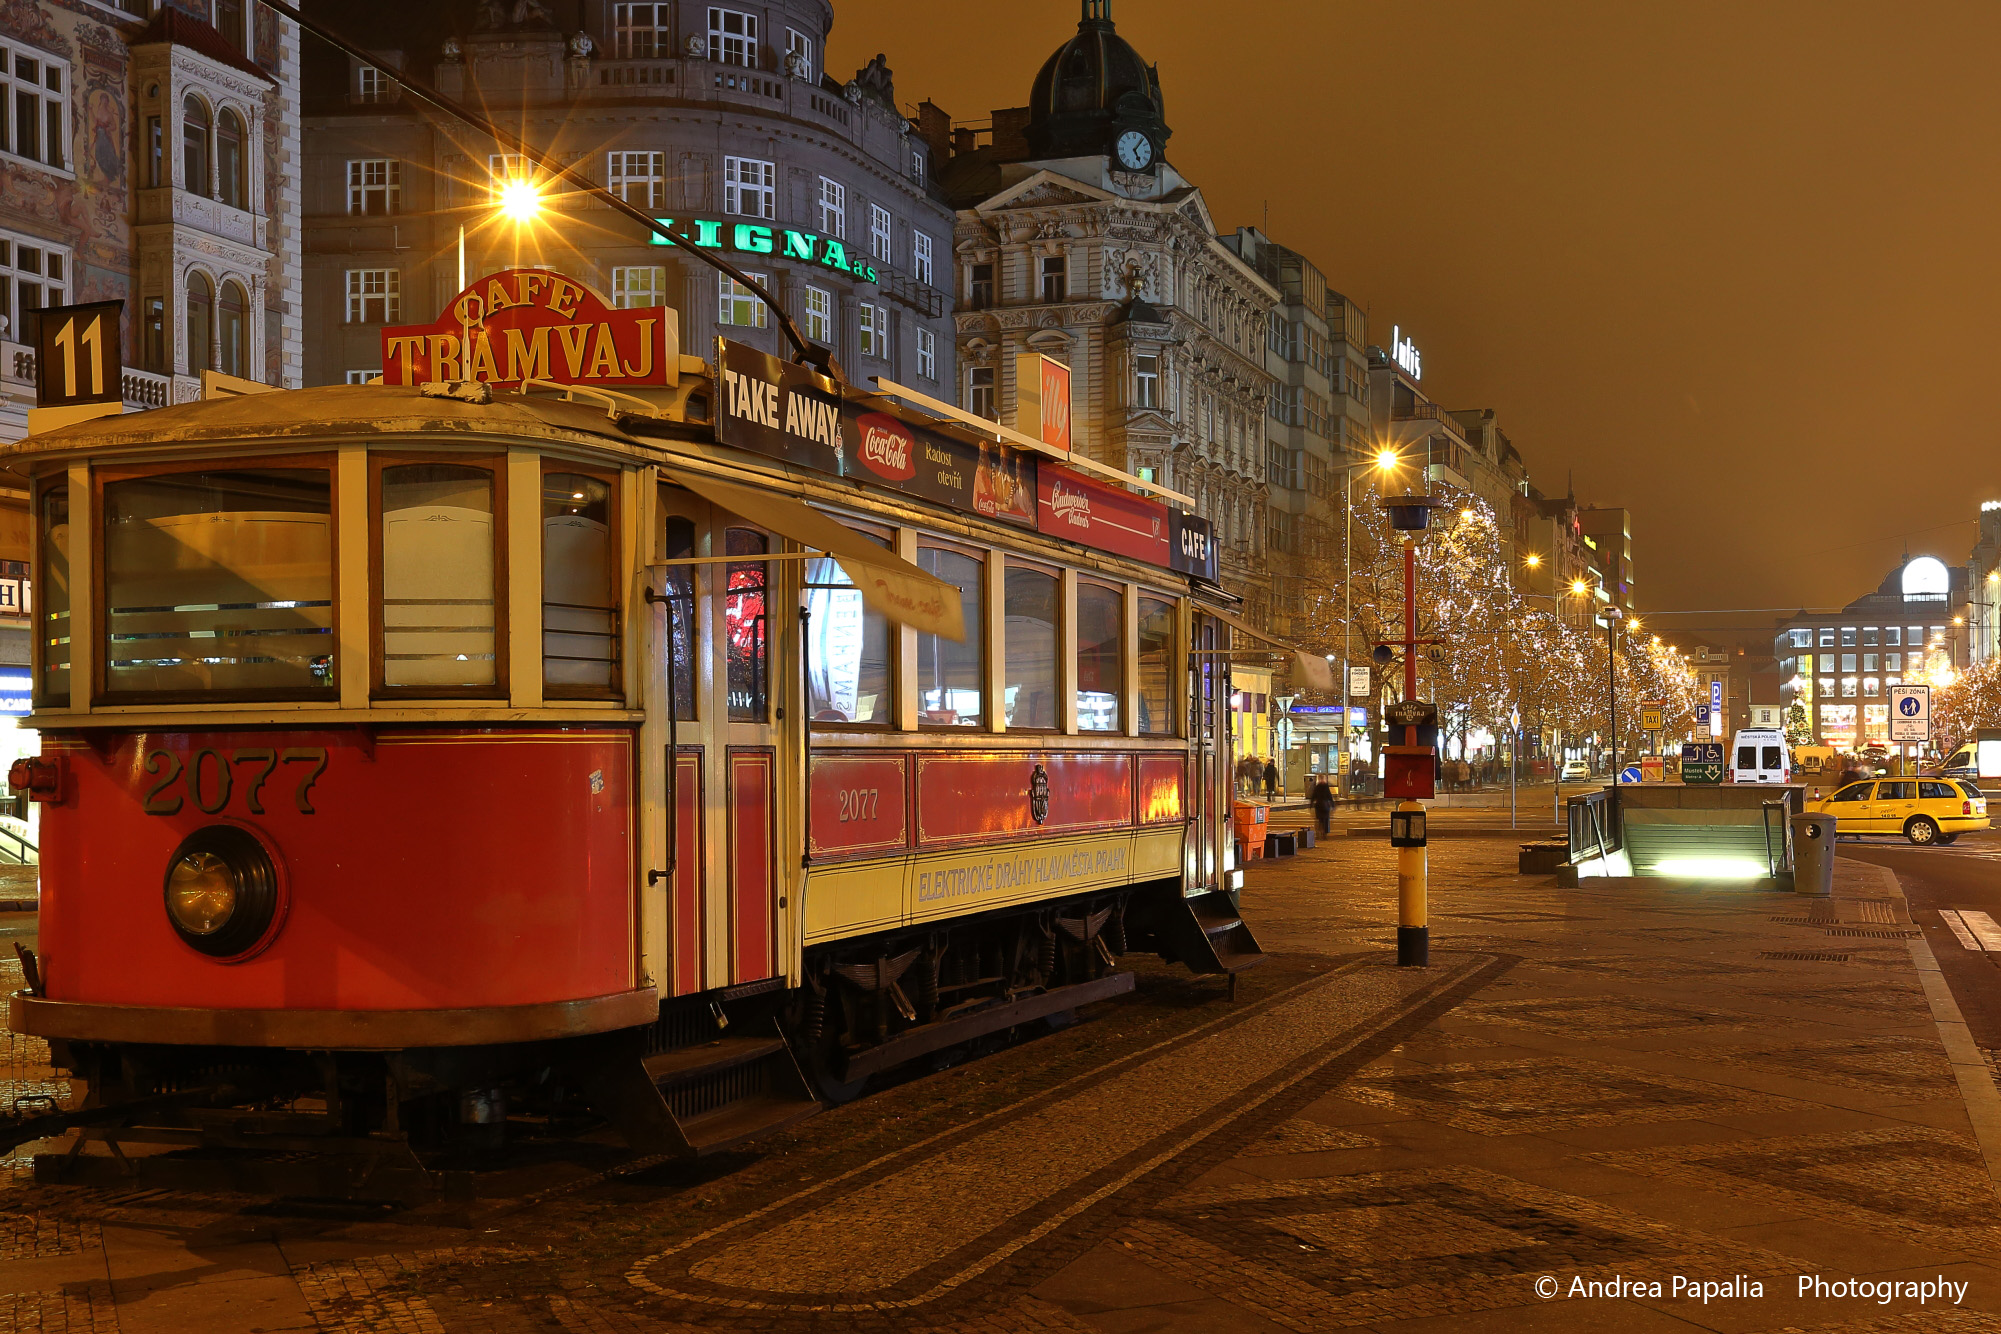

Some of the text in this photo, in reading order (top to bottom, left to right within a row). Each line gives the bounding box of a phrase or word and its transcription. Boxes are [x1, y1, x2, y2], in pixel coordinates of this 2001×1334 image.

[648, 218, 850, 271] LIGNA
[453, 272, 585, 328] CAFE
[54, 313, 104, 397] 11
[387, 317, 658, 388] TRAMVAJ
[725, 369, 780, 430] TAKE
[785, 390, 839, 447] AWAY
[1043, 374, 1067, 442] illy
[865, 425, 907, 471] Coca-Cola
[925, 441, 952, 467] Radost
[937, 470, 962, 490] otevřít
[1051, 480, 1091, 513] Budweiser
[1181, 527, 1206, 561] CAFE
[1431, 649, 1441, 658] 11
[1645, 715, 1659, 724] TAXI
[1699, 707, 1707, 719] P
[142, 746, 329, 816] 2077
[839, 788, 879, 823] 2077
[918, 857, 993, 902] ELEKTRICKÉ
[995, 855, 1034, 889] DRÁHY
[1061, 847, 1093, 878] MĚSTA
